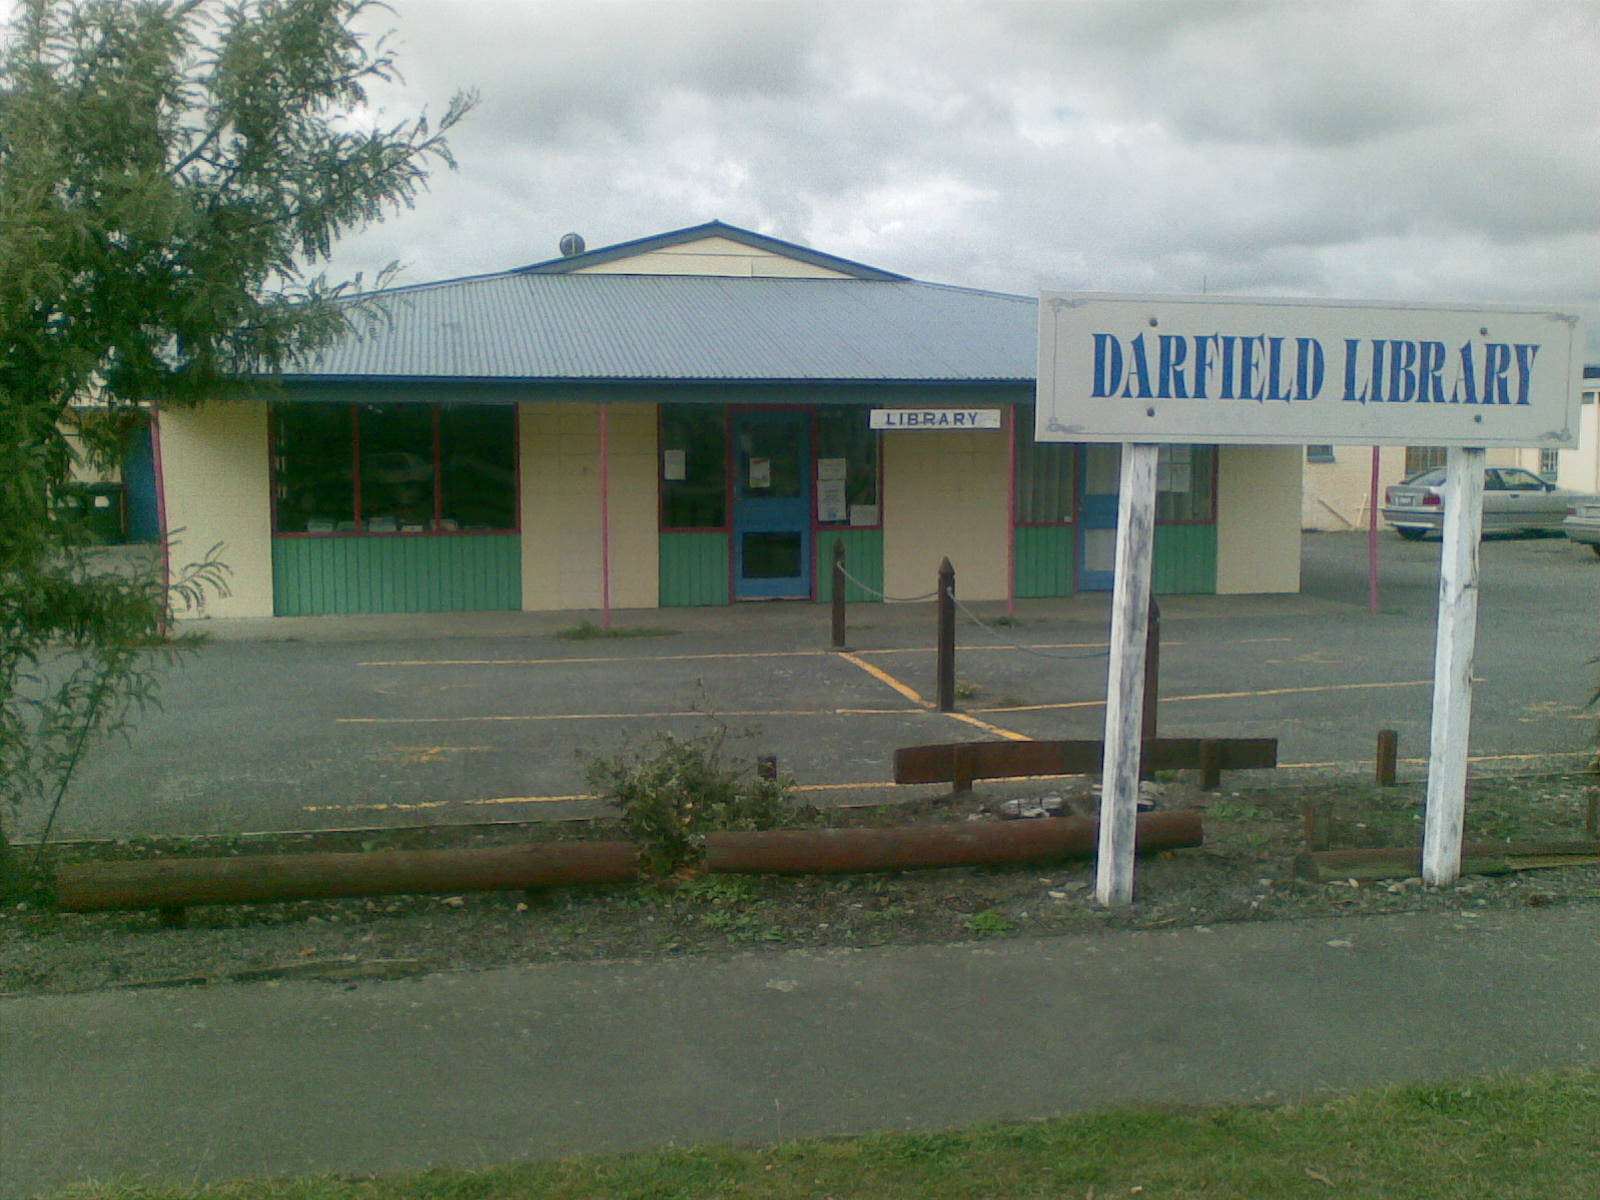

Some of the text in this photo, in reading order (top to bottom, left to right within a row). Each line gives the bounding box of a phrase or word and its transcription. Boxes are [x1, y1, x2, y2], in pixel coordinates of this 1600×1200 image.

[1091, 332, 1539, 405] DARFIELD LIBRARY
[886, 412, 979, 426] LIBRARY
